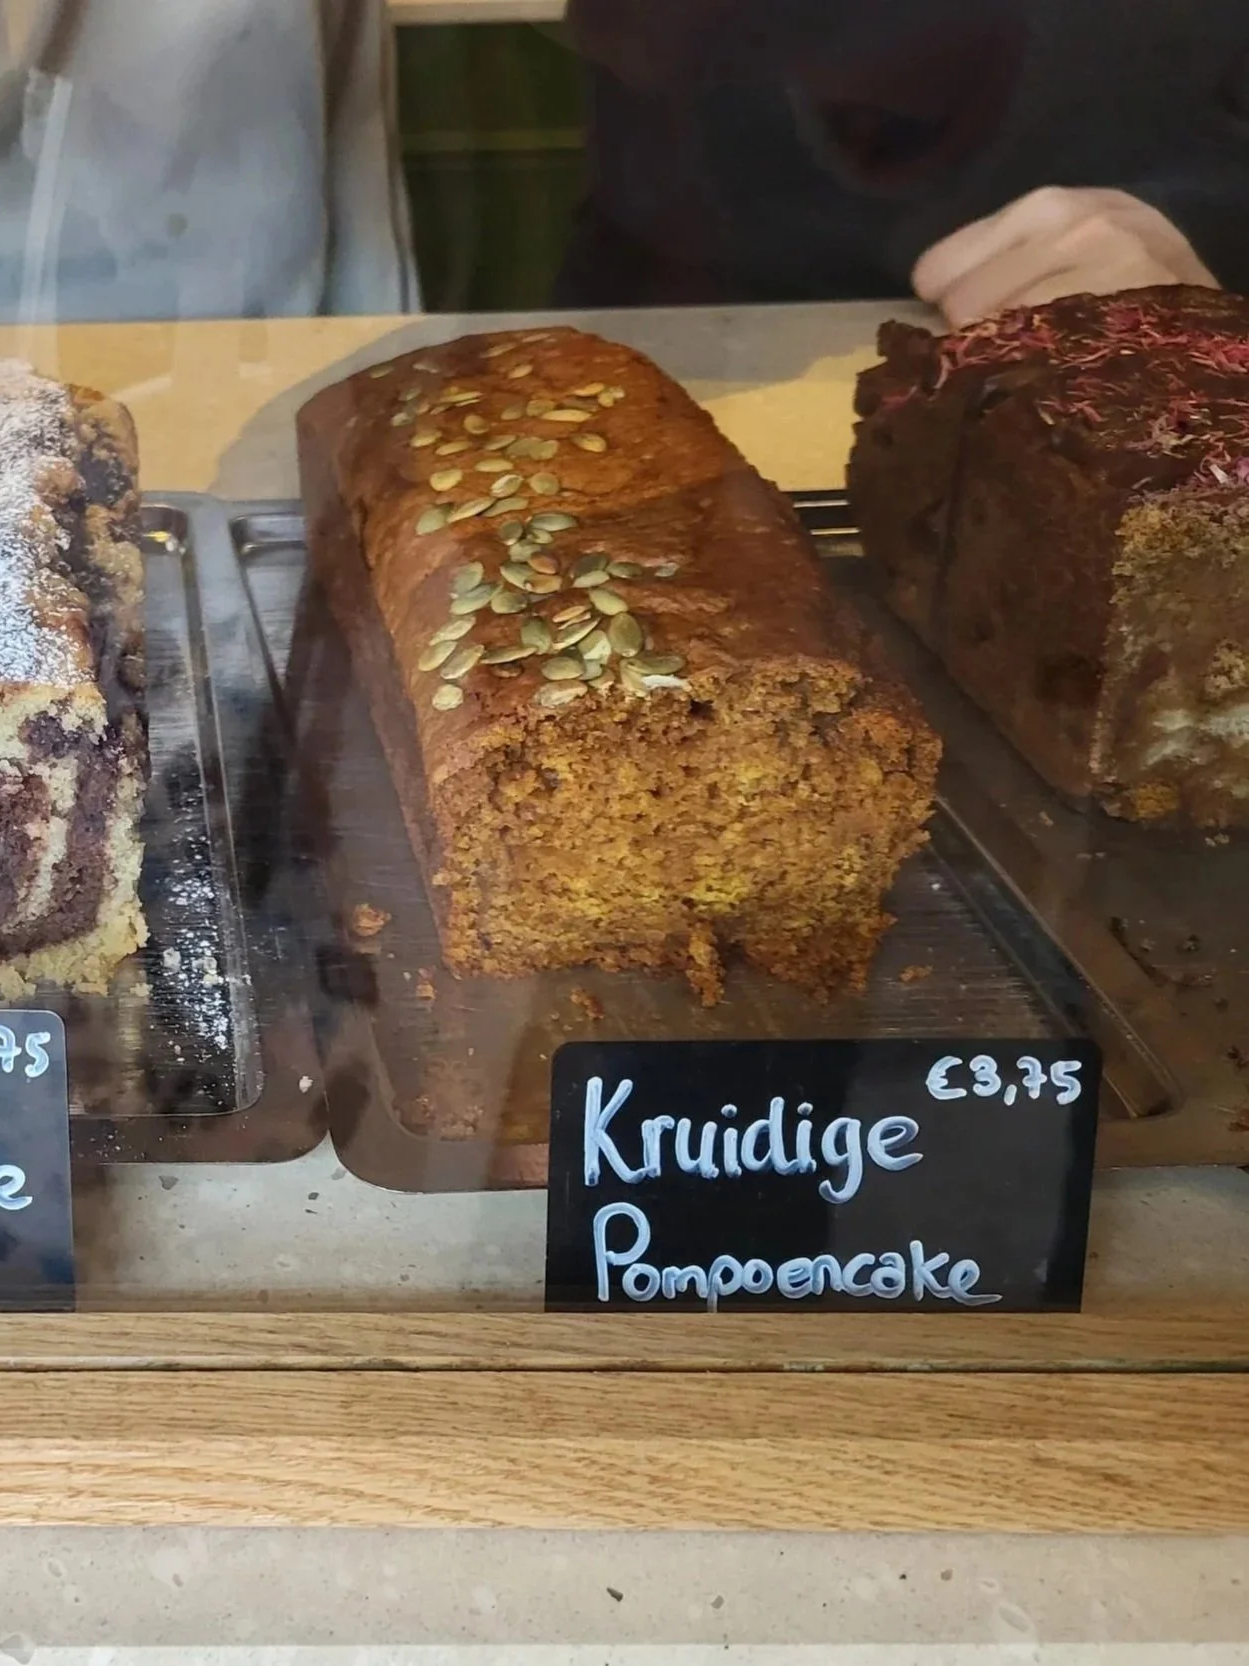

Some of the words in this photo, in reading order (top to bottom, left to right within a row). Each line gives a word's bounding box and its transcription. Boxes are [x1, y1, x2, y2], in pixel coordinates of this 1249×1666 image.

[925, 1054, 1084, 1106] €3,75
[583, 1075, 924, 1204] Kruidige
[592, 1201, 1004, 1312] Pompoencake
